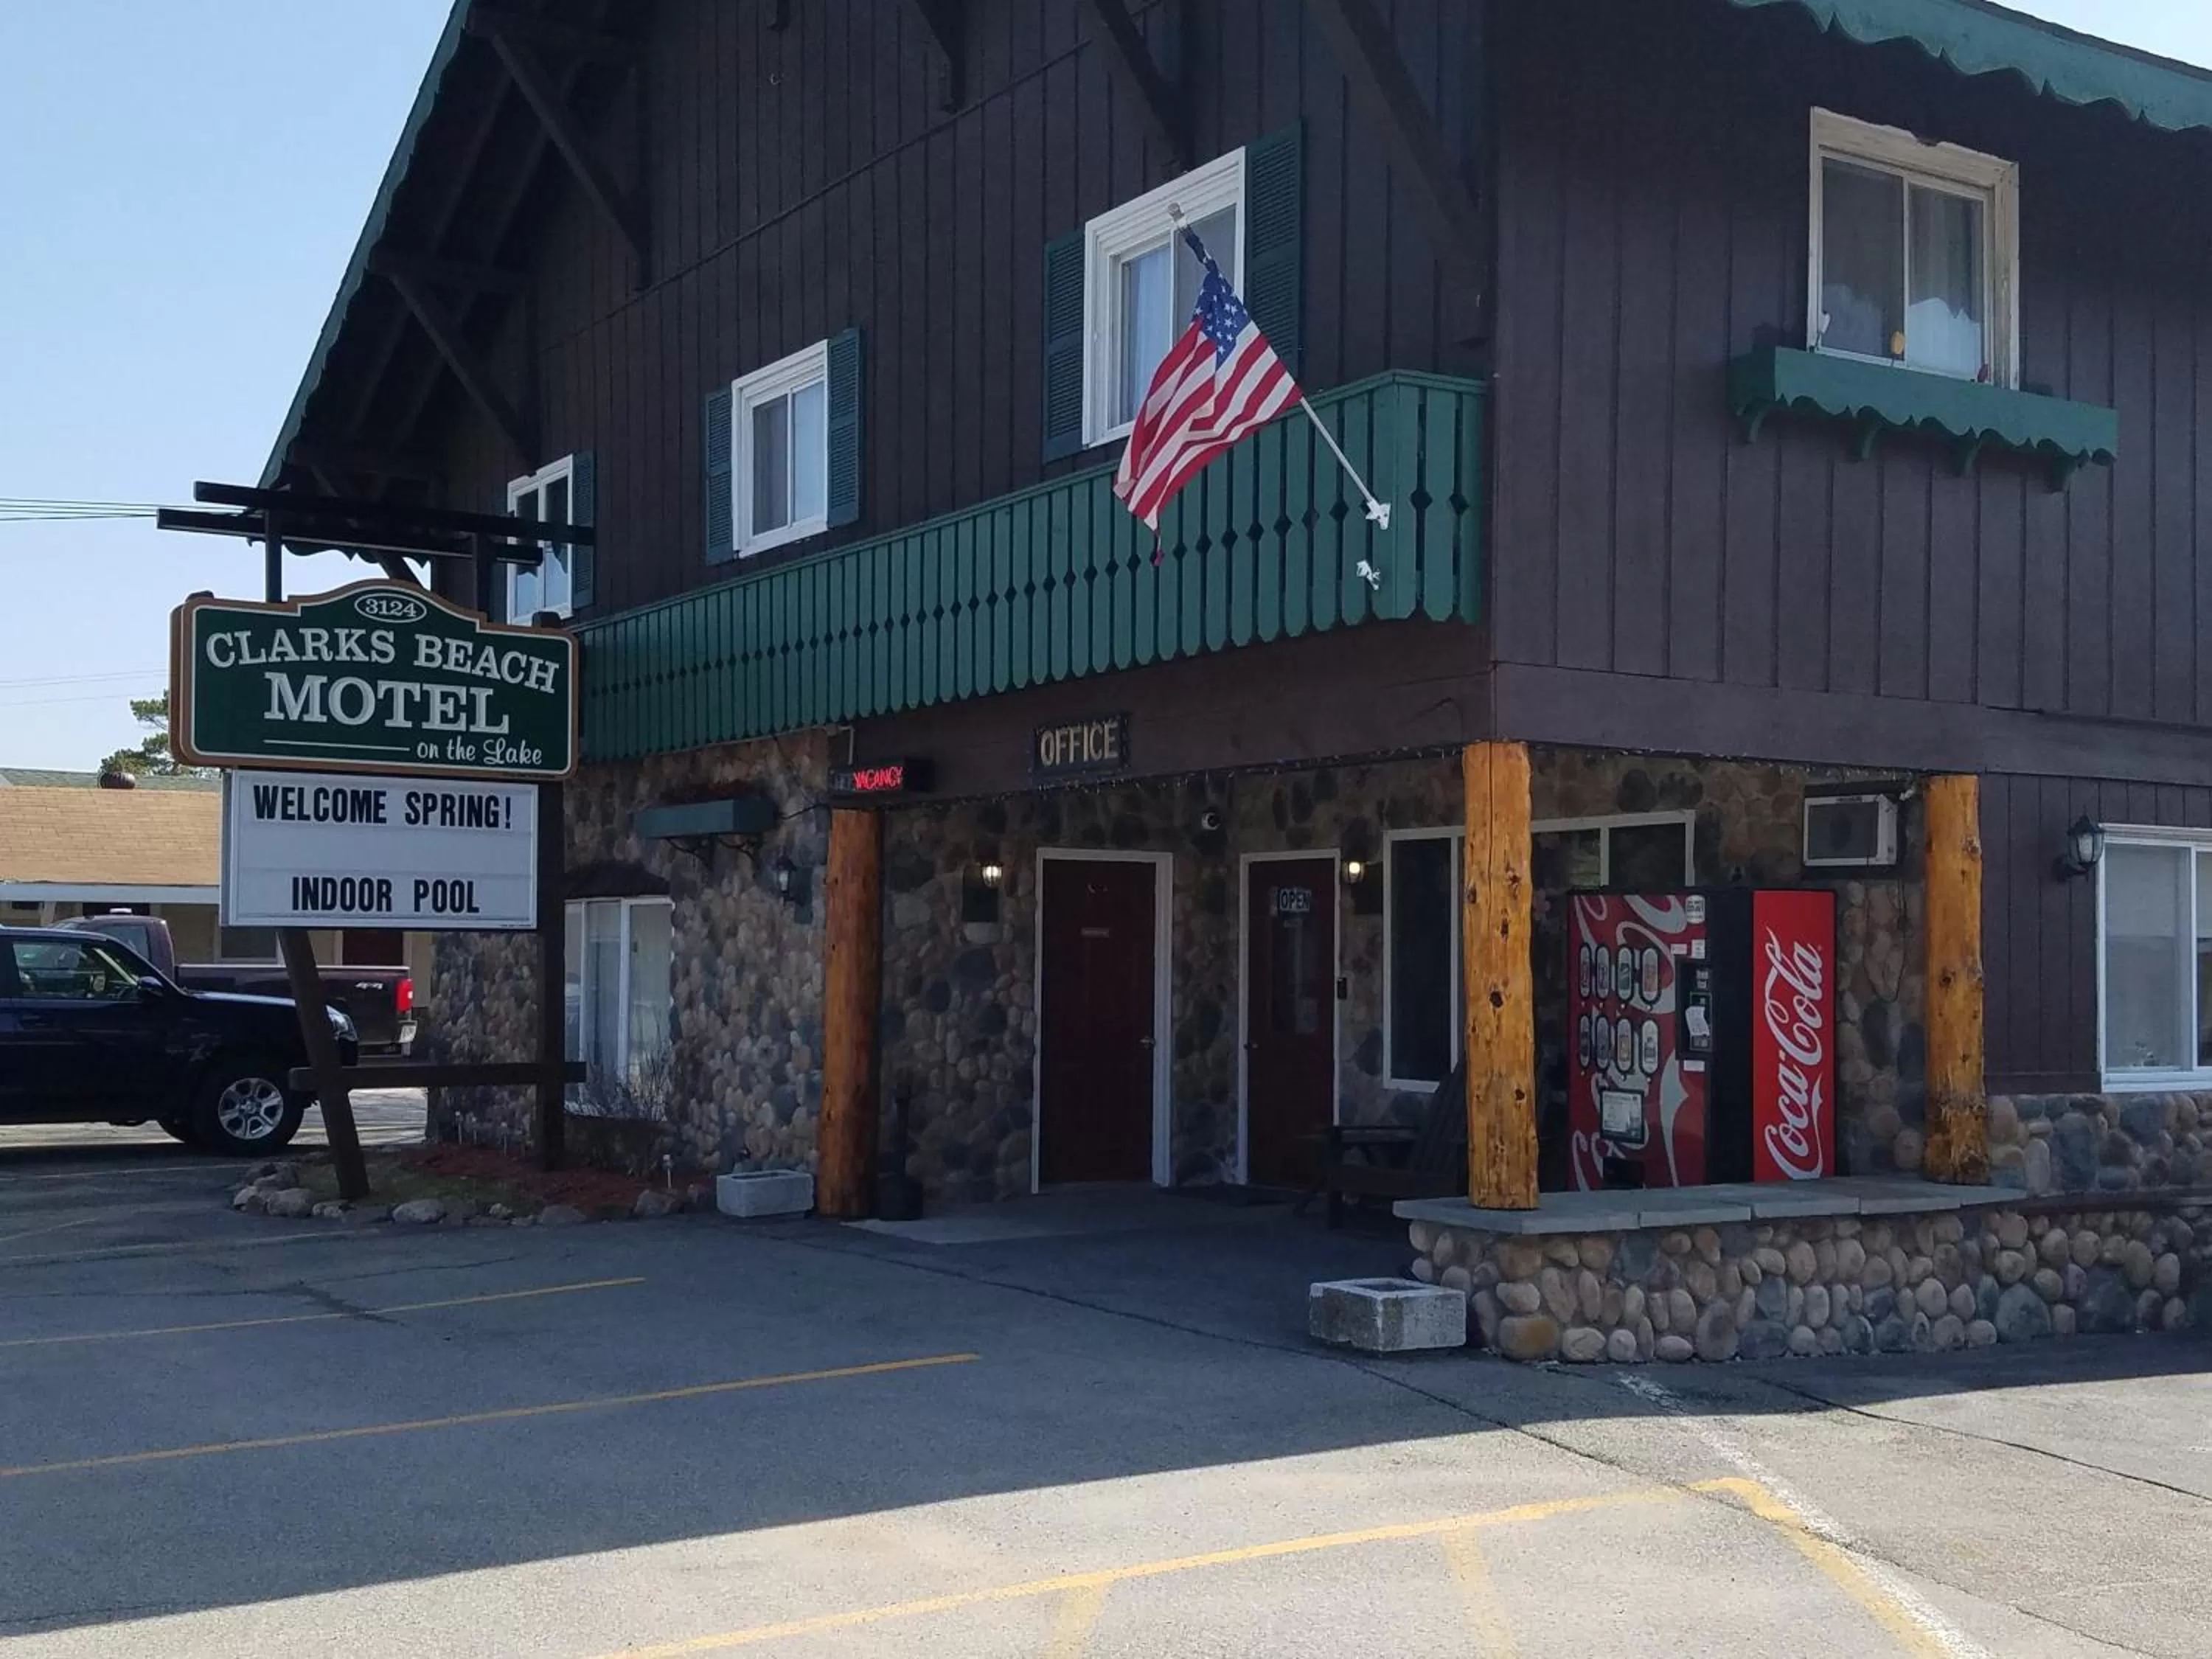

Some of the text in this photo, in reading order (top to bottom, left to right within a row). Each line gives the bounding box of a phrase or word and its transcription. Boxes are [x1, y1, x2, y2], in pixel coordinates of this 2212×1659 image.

[365, 599, 417, 618] 3124
[206, 628, 560, 694] CLARKS BEACH
[263, 672, 509, 734] MOTEL
[417, 736, 542, 765] on the Lake
[1040, 720, 1119, 767] OFFICE
[254, 785, 512, 830] WELCOME SPRING!
[291, 877, 480, 914] INDOOR POOL
[1281, 891, 1310, 910] OPEN
